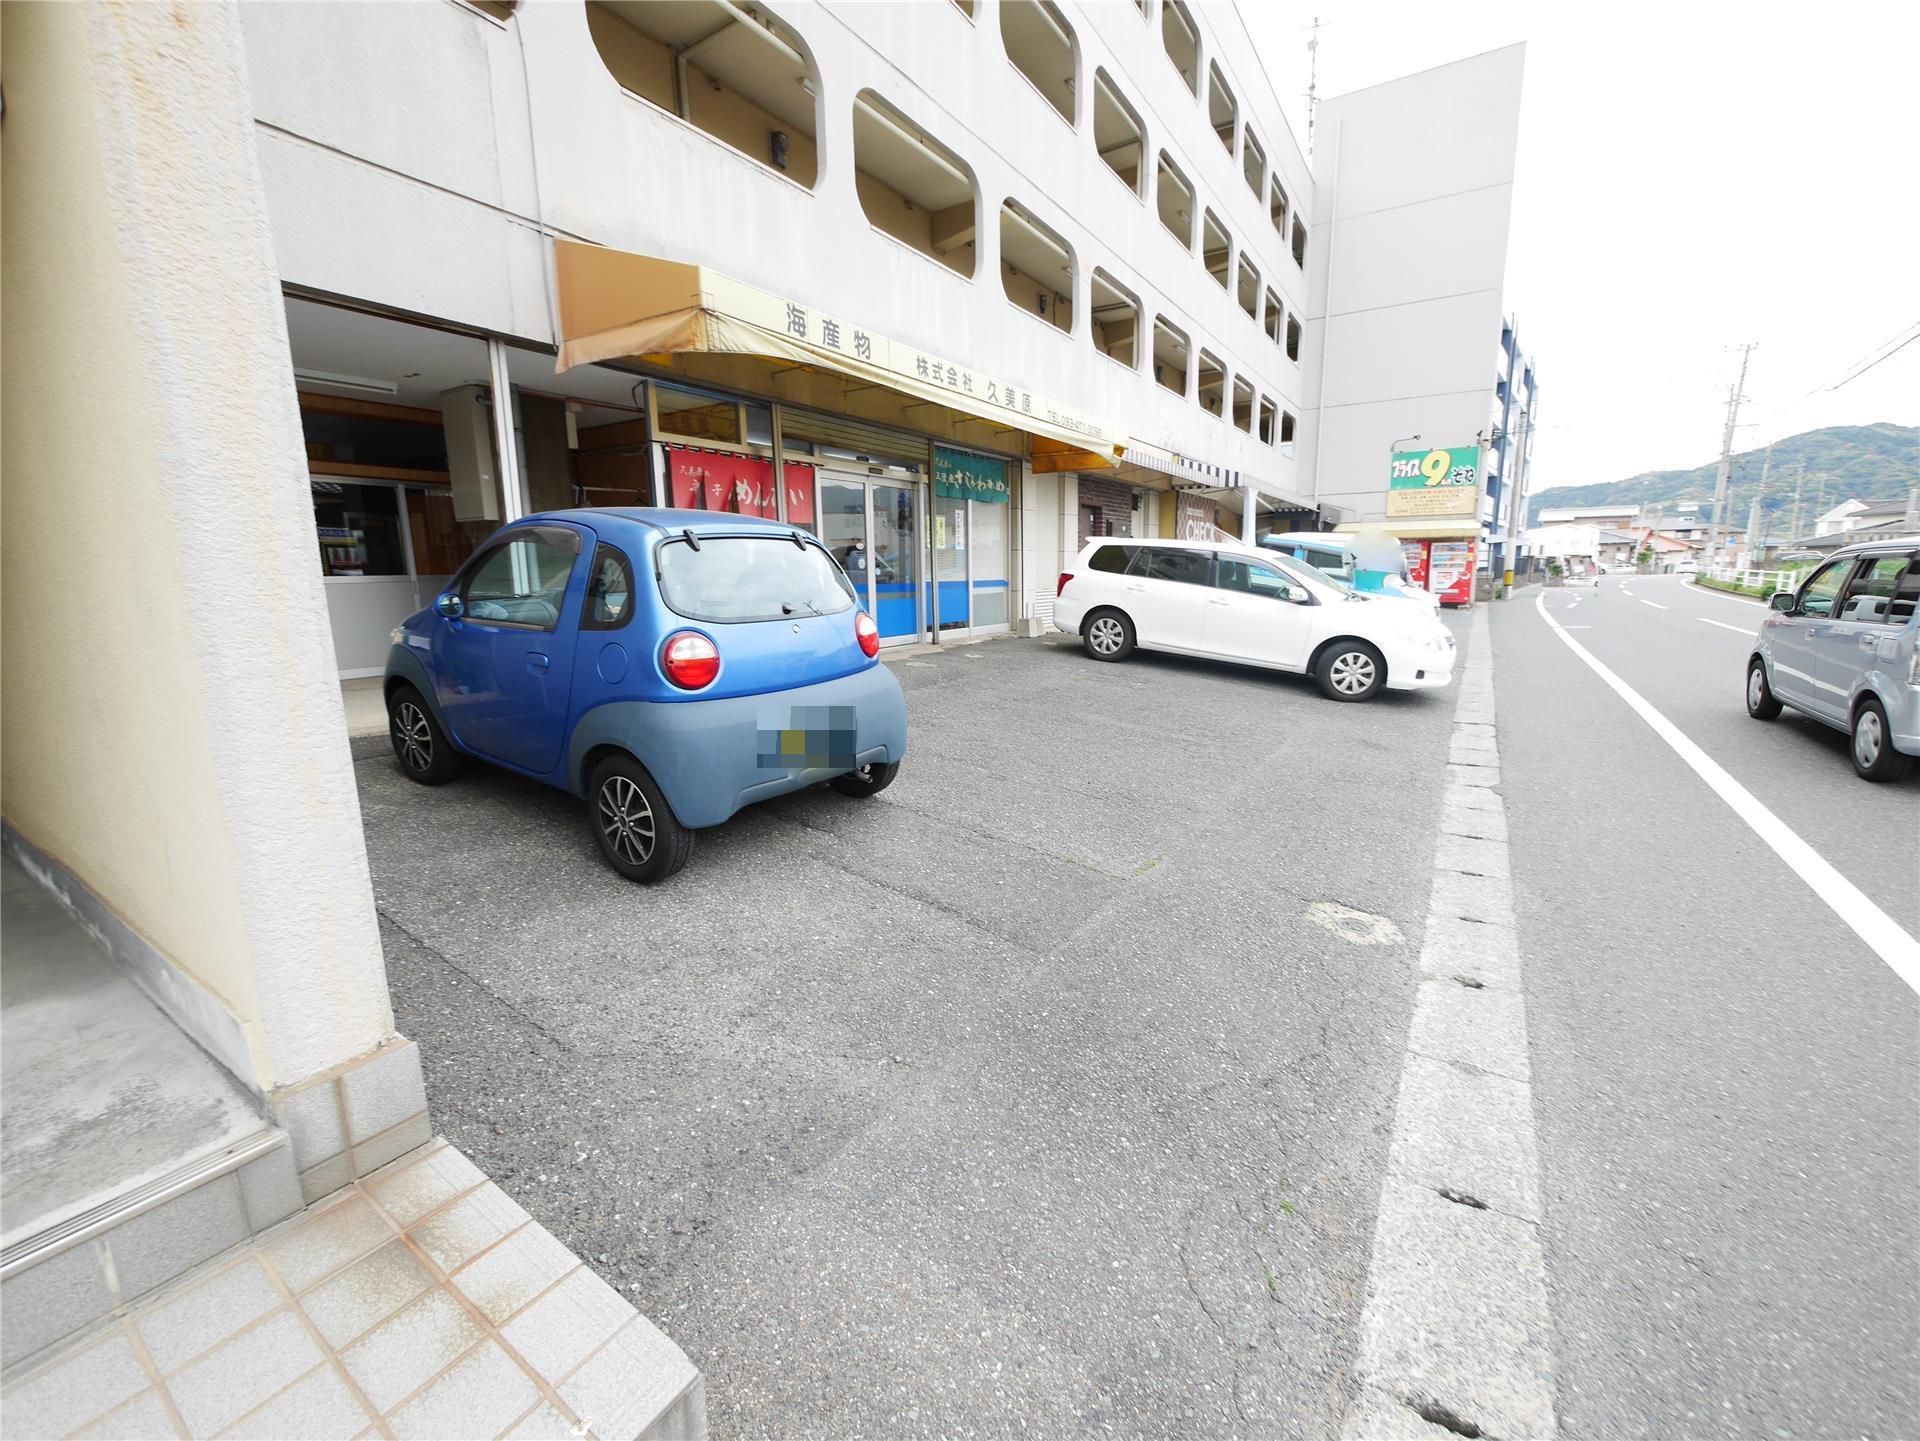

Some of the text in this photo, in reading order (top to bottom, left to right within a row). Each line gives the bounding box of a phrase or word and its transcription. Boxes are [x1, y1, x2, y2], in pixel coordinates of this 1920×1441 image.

[786, 303, 871, 360] 海産物
[916, 354, 1032, 414] 株式会社 久美原
